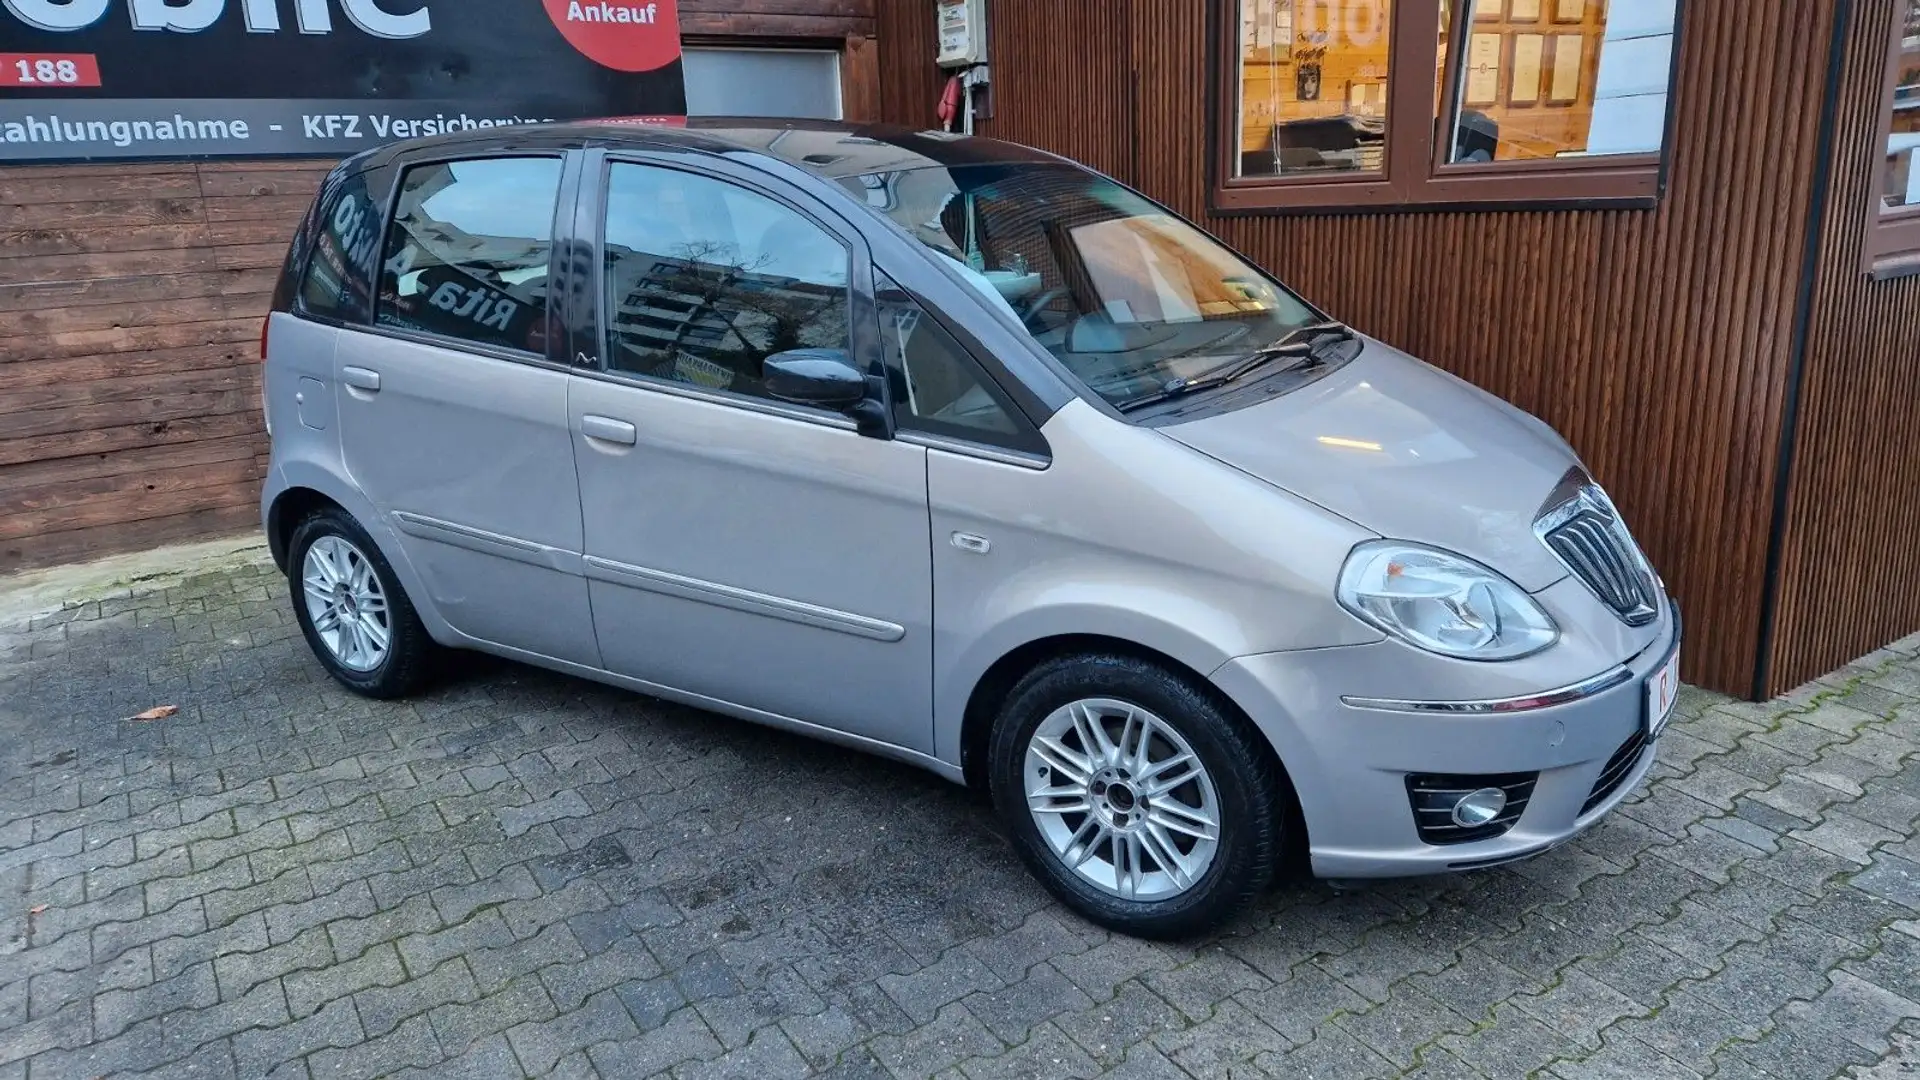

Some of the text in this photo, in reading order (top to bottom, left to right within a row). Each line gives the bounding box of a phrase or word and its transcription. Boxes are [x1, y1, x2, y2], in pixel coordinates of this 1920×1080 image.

[567, 1, 656, 23] Ankauf
[16, 60, 78, 83] 188
[0, 114, 249, 146] ahlungnahme
[302, 115, 362, 138] KFZ
